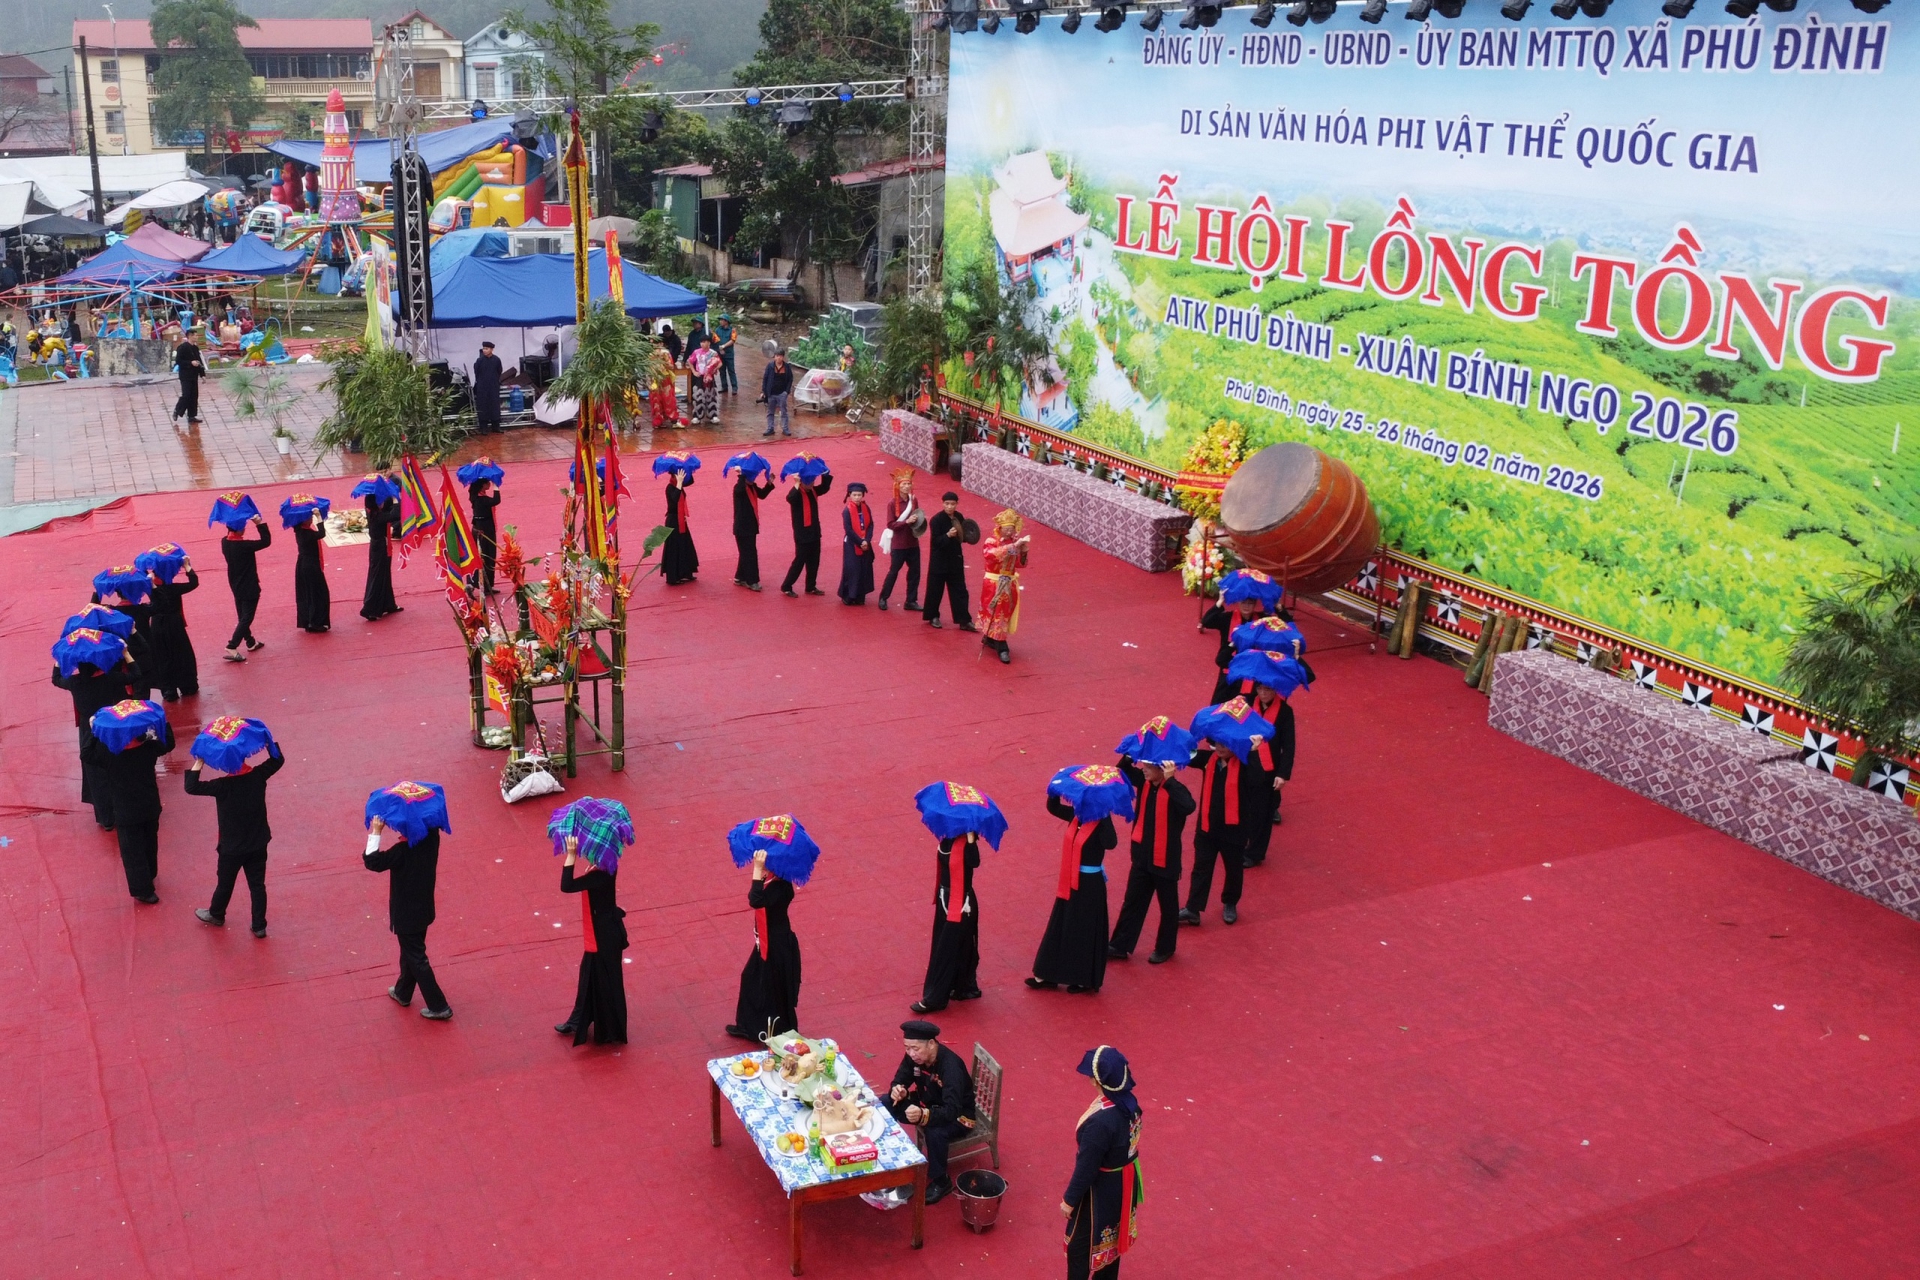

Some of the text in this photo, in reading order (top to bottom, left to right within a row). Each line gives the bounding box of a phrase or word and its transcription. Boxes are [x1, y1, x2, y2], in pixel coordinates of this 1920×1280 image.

[1143, 28, 1192, 65] ĐẢNG
[1198, 28, 1224, 65] ỦY
[1241, 34, 1302, 65] HĐND
[1324, 33, 1391, 65] UBND
[1416, 23, 1452, 67] ỦY
[1459, 31, 1518, 67] BAN
[1527, 30, 1615, 75] MTTQ
[1623, 21, 1669, 69] XÃ
[1681, 17, 1760, 70] PHÚ
[1773, 17, 1887, 70] ĐÌNH
[1180, 103, 1759, 173] DI SẢN VĂN HÓA PHI VẬT THỂ QUỐC GIA
[1114, 174, 1893, 377] LỄ HỘI LỒNG TỒNG
[1165, 297, 1207, 331] ATK
[1214, 306, 1261, 342] PHÚ
[1268, 313, 1332, 359] ĐÌNH
[1356, 335, 1438, 384] XUÂN
[1449, 351, 1530, 405] BÍNH
[1540, 374, 1618, 432] NGỌ
[1629, 394, 1736, 453] 2026
[1225, 379, 1252, 401] Phú
[1256, 385, 1292, 416] Đình,
[1297, 401, 1339, 428] ngày
[1342, 411, 1363, 431] 25
[1377, 421, 1399, 442] 26
[1403, 428, 1459, 463] tháng
[1464, 444, 1489, 467] 02
[1493, 454, 1540, 482] năm
[1546, 467, 1601, 499] 2026
